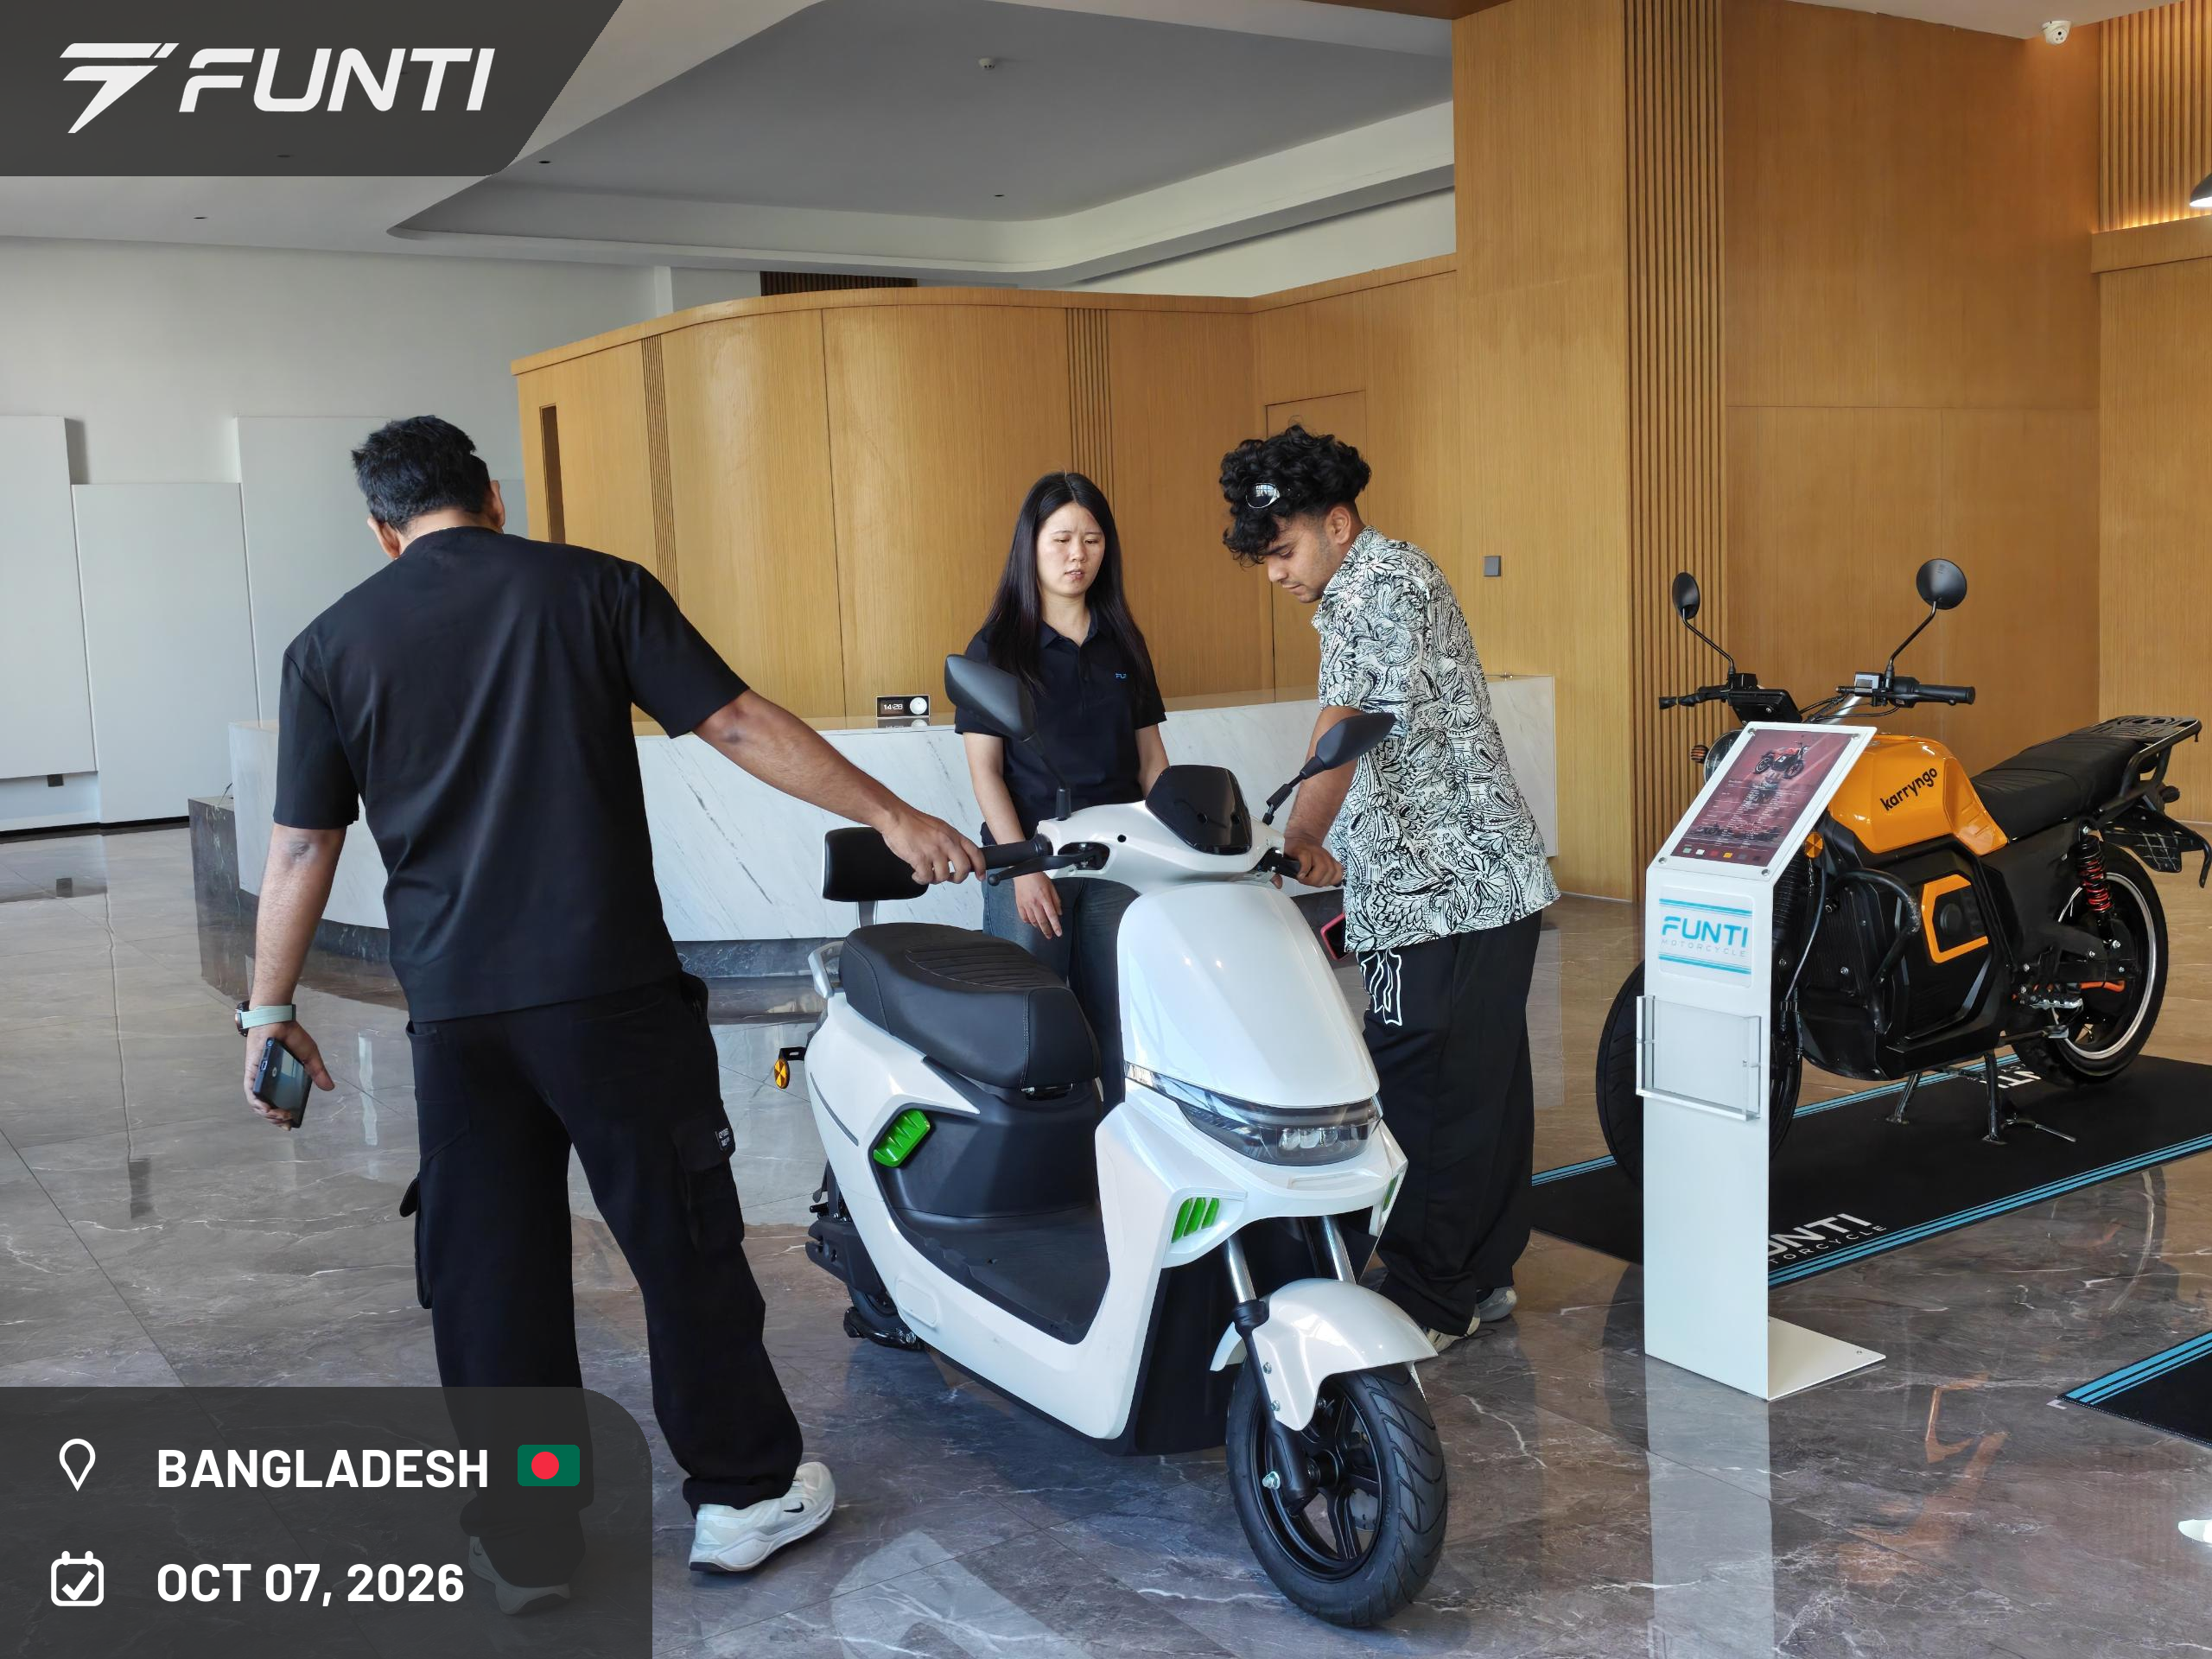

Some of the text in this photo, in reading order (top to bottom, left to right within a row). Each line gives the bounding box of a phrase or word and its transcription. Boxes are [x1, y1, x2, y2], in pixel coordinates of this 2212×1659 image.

[1879, 767, 1938, 811] karryngo
[1660, 938, 1748, 957] MOTORCYCLE
[1662, 915, 1749, 948] FUNTI
